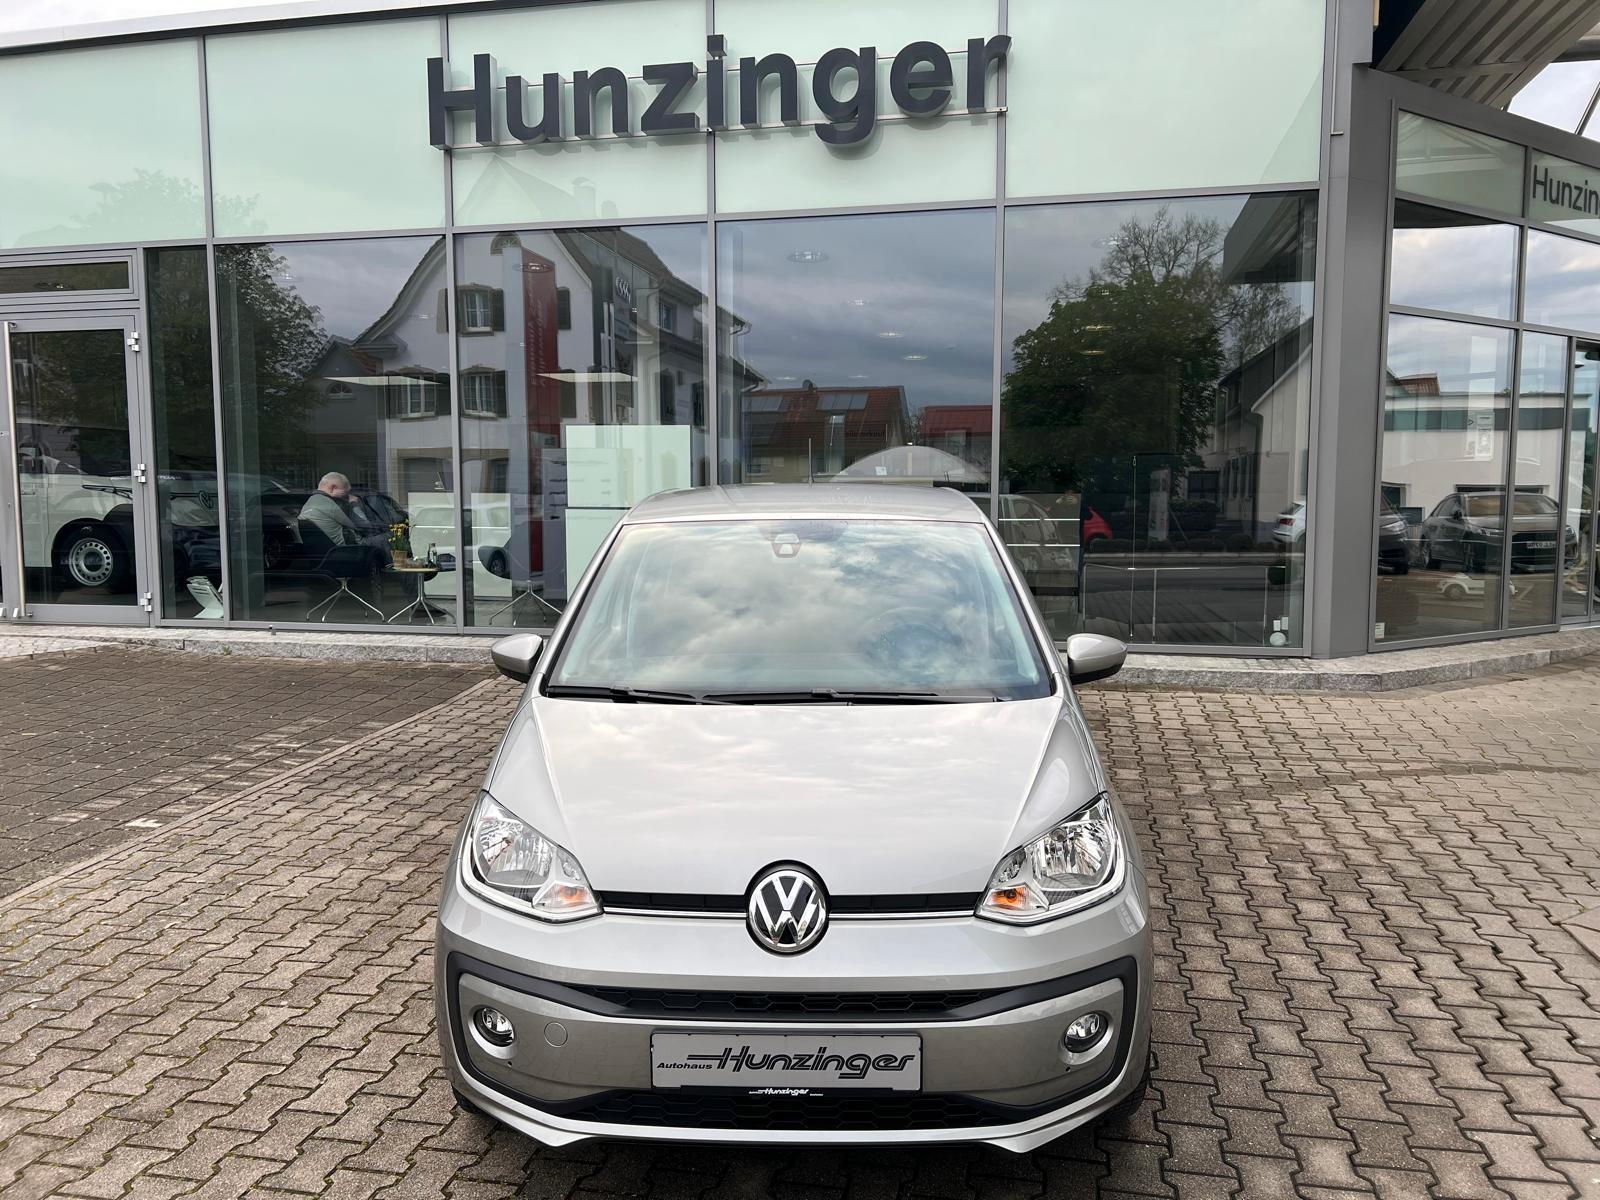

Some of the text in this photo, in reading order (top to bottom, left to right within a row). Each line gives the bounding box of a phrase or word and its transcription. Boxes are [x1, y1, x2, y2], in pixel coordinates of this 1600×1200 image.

[426, 34, 1012, 149] Hunzinger
[1532, 164, 1600, 216] Hunzin
[656, 1046, 916, 1080] Autohaus Hunzinger
[757, 1087, 810, 1097] Hunzinger
